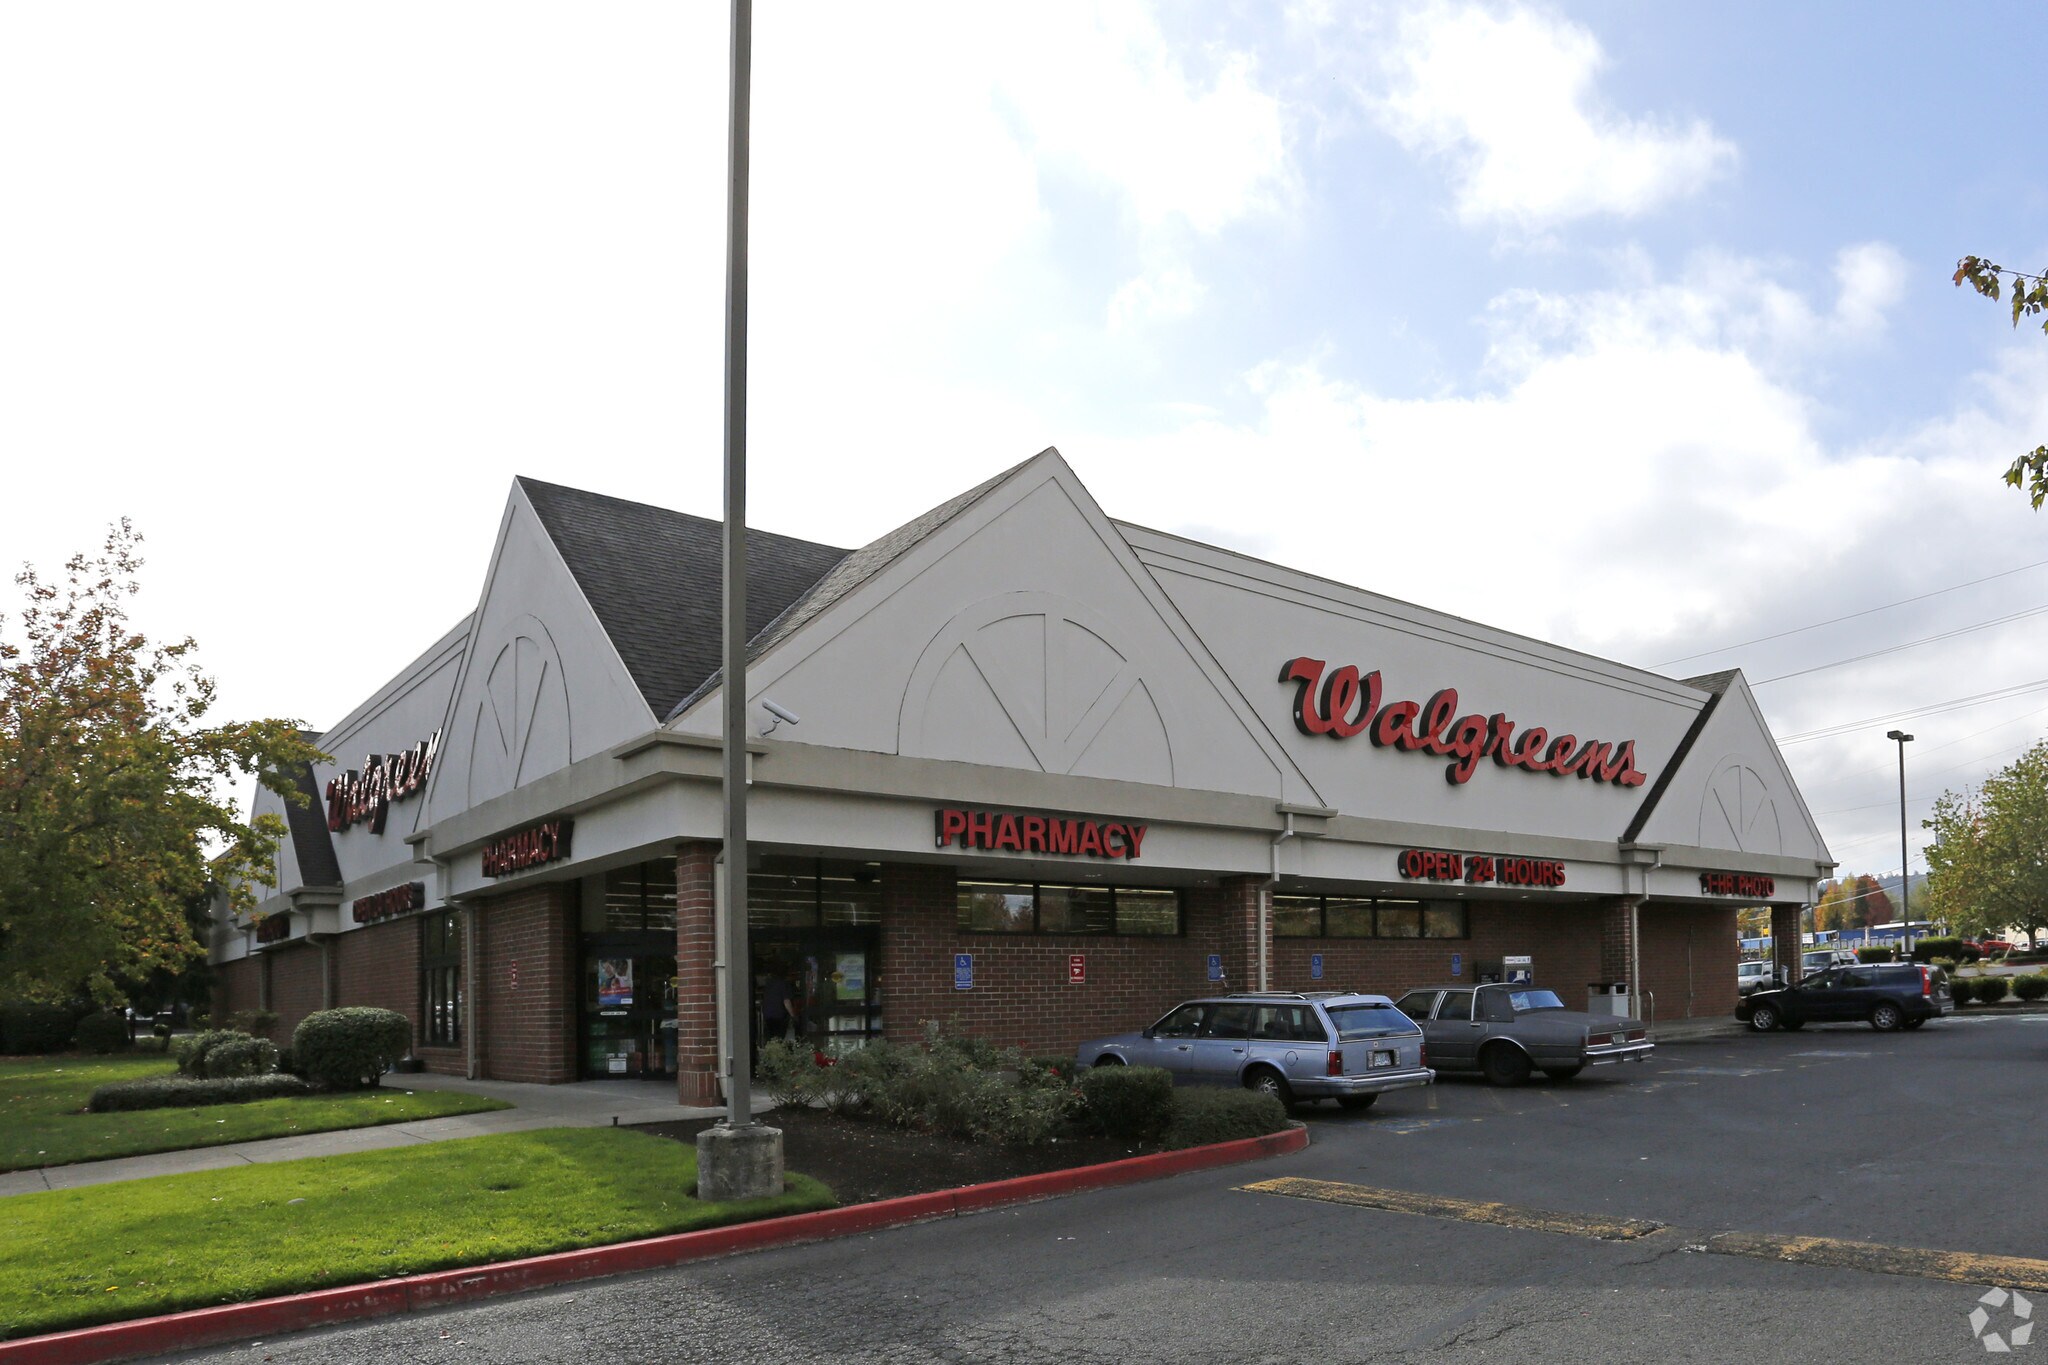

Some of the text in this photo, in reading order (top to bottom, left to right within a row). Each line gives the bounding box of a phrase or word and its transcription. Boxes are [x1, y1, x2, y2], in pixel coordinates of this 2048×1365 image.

[1280, 656, 1647, 786] Walgreens
[326, 727, 443, 833] Walgreen
[482, 819, 565, 877] PHARMACY
[937, 808, 1148, 860] PHARMACY
[1401, 849, 1566, 887] OPEN 24 HOURS
[1704, 872, 1776, 897] 1-HR PHOTO
